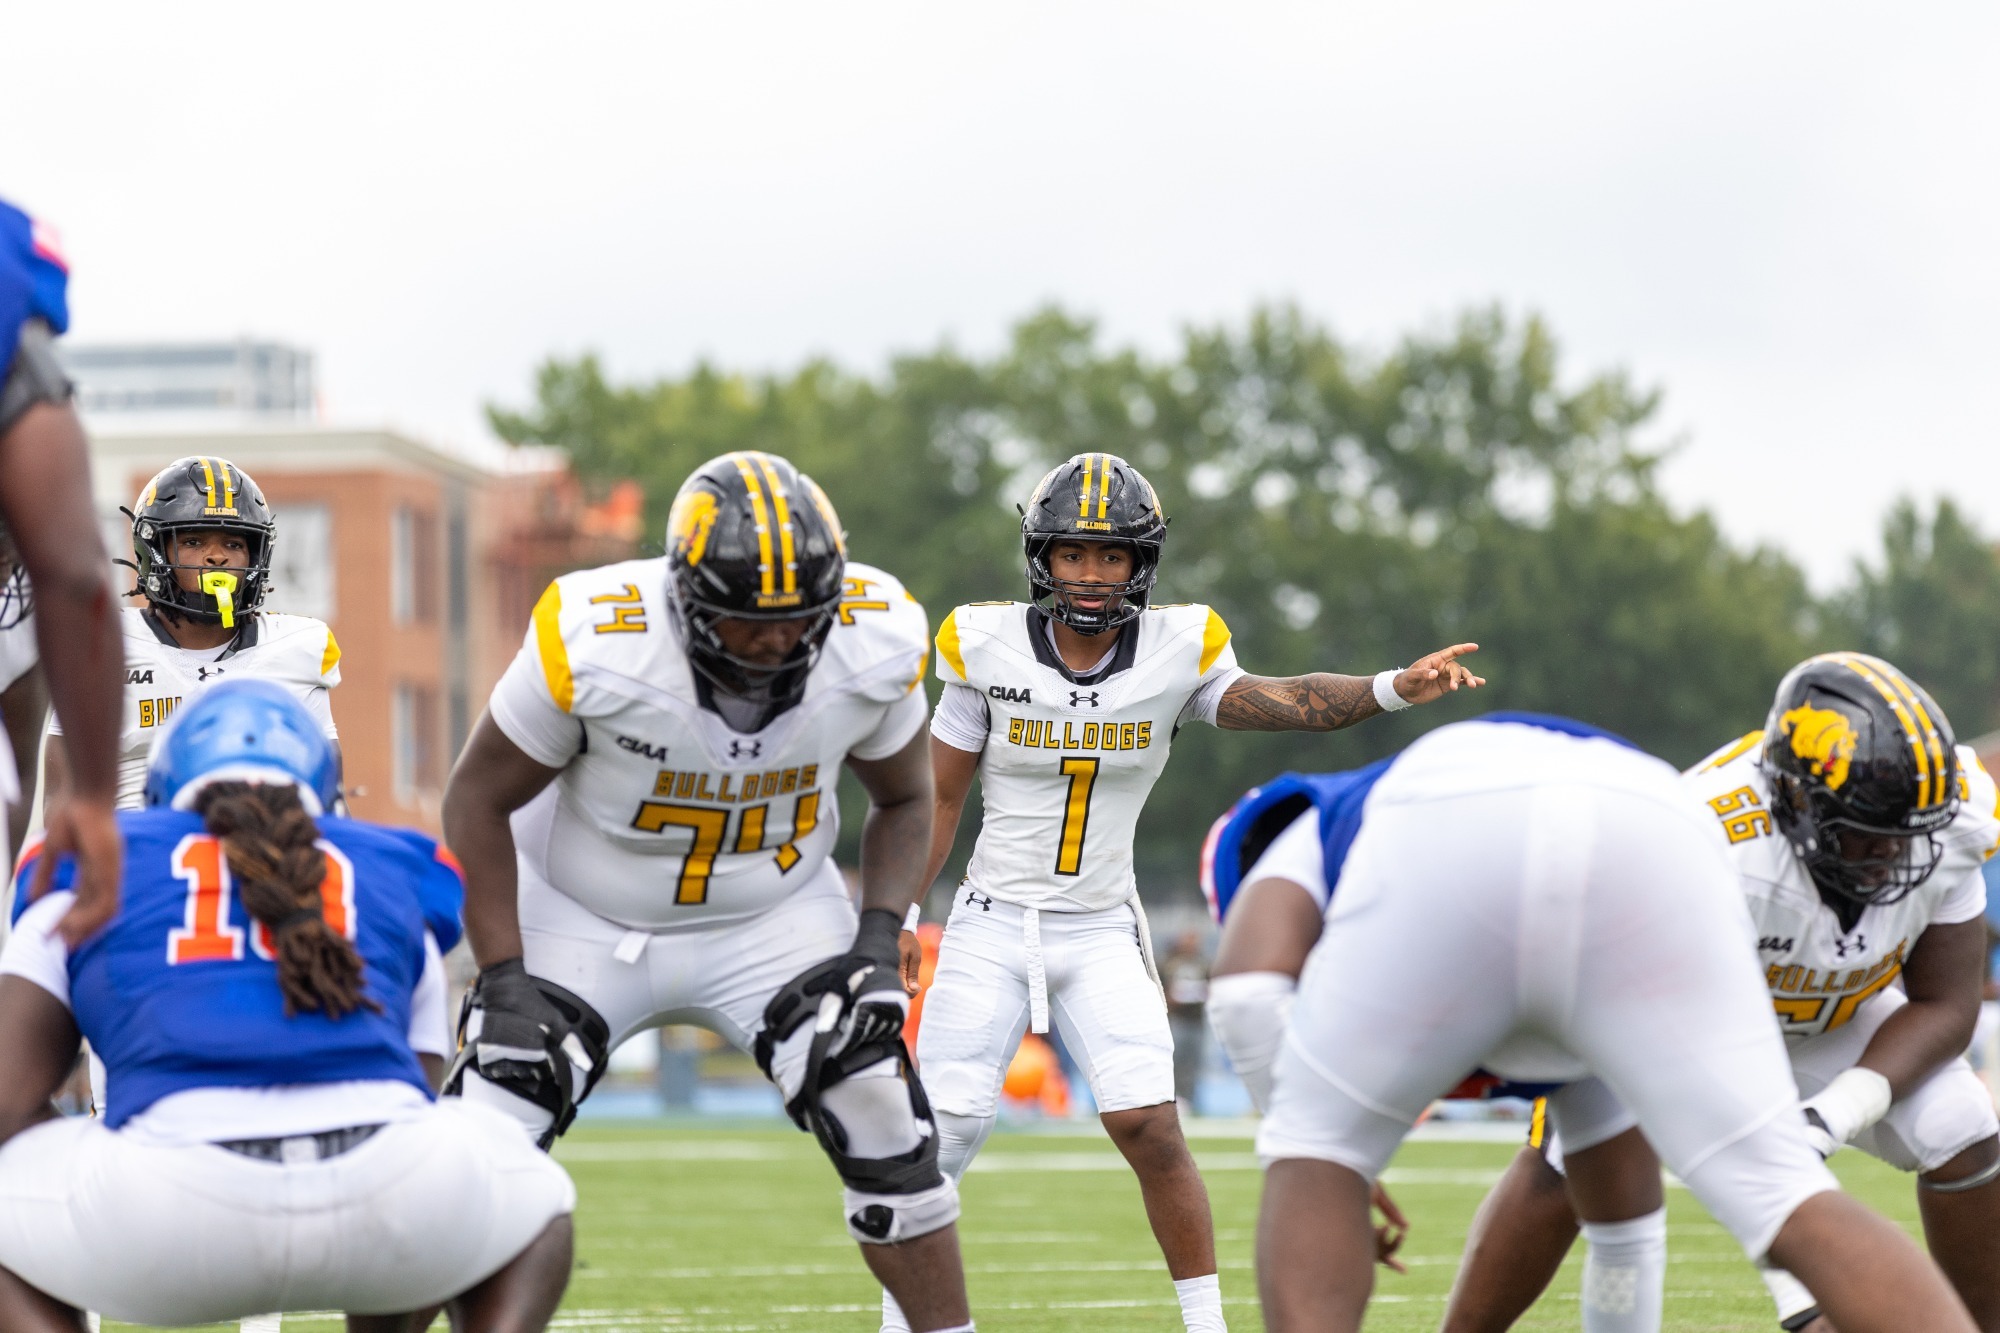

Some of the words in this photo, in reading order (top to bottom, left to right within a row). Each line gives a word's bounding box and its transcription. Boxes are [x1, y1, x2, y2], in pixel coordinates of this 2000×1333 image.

[1076, 520, 1111, 531] BULLDOGS
[589, 584, 648, 634] 74
[124, 669, 154, 685] IAA
[989, 685, 1032, 703] CIAA
[616, 734, 668, 763] CIAA
[1009, 718, 1152, 750] BULLDOGS
[655, 764, 818, 802] BULLDOGS
[1055, 757, 1100, 877] 1
[1708, 785, 1773, 844] 66
[631, 789, 821, 905] 74
